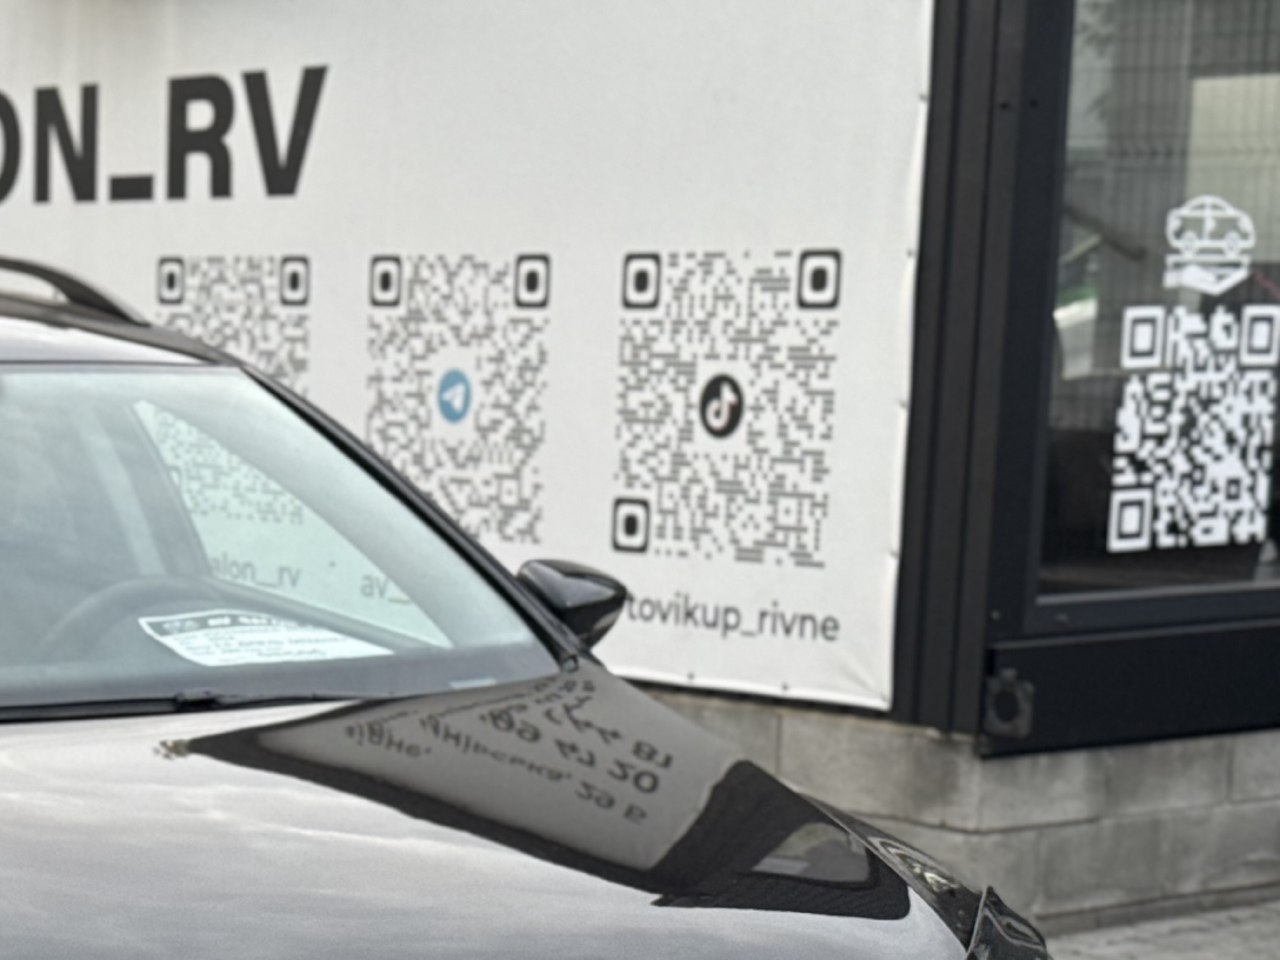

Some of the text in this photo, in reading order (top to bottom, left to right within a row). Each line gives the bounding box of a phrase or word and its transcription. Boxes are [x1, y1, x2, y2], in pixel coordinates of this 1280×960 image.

[209, 552, 300, 588] alon_rv
[360, 574, 413, 605] av_
[626, 591, 840, 641] tovikup_rivne
